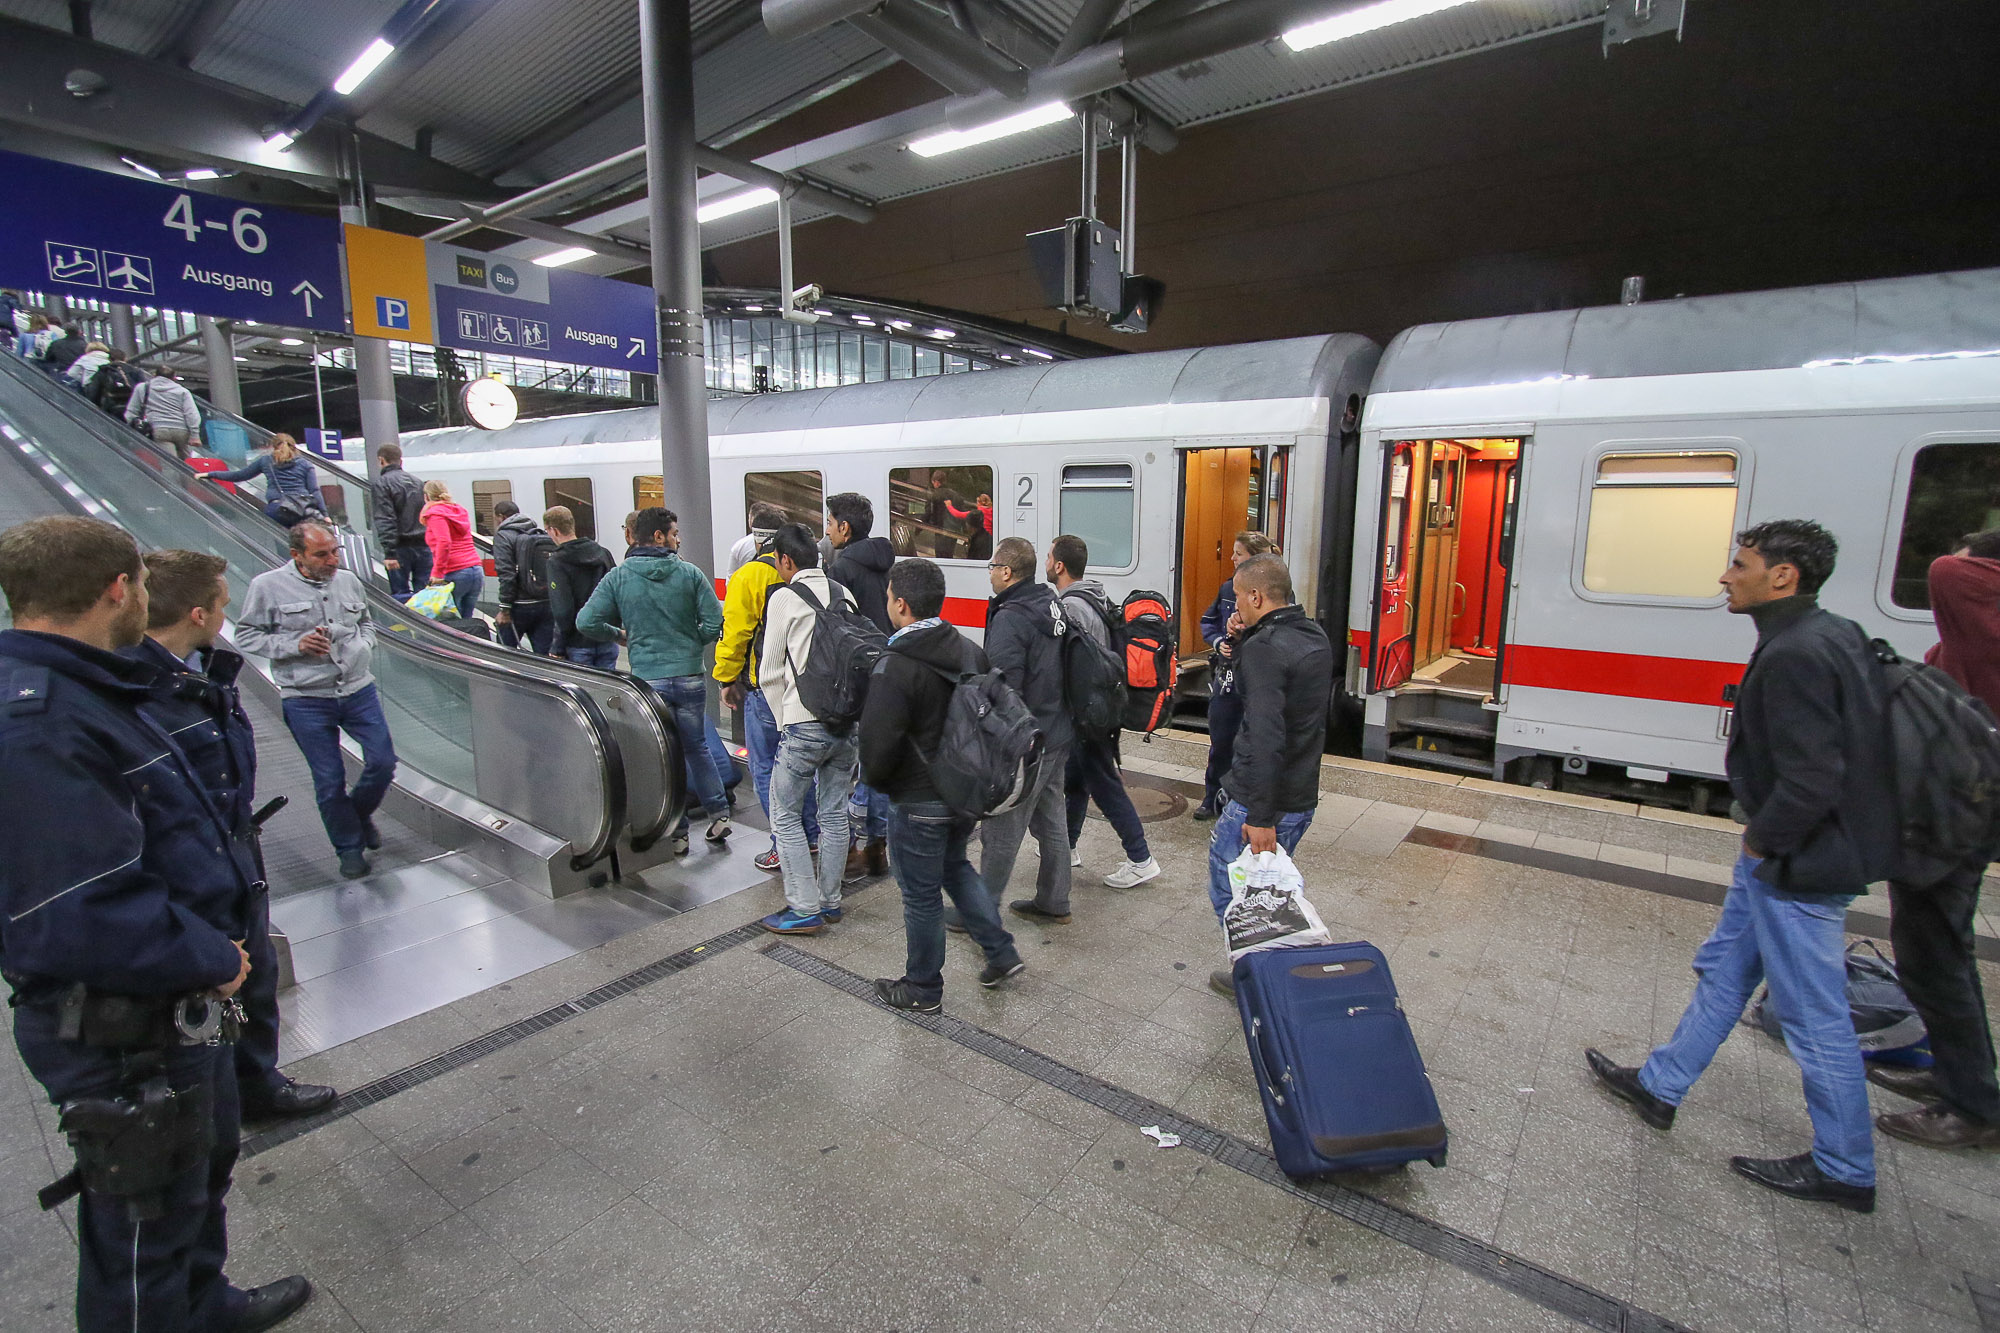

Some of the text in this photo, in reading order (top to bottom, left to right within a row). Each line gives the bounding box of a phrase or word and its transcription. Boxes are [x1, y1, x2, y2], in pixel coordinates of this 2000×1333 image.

[163, 193, 268, 254] 4-6
[182, 264, 273, 296] Ausgang
[460, 264, 484, 279] TAXI
[496, 273, 515, 286] Bus
[384, 299, 406, 327] P
[565, 326, 618, 349] Ausgang
[320, 430, 339, 454] E
[1017, 476, 1033, 507] 2
